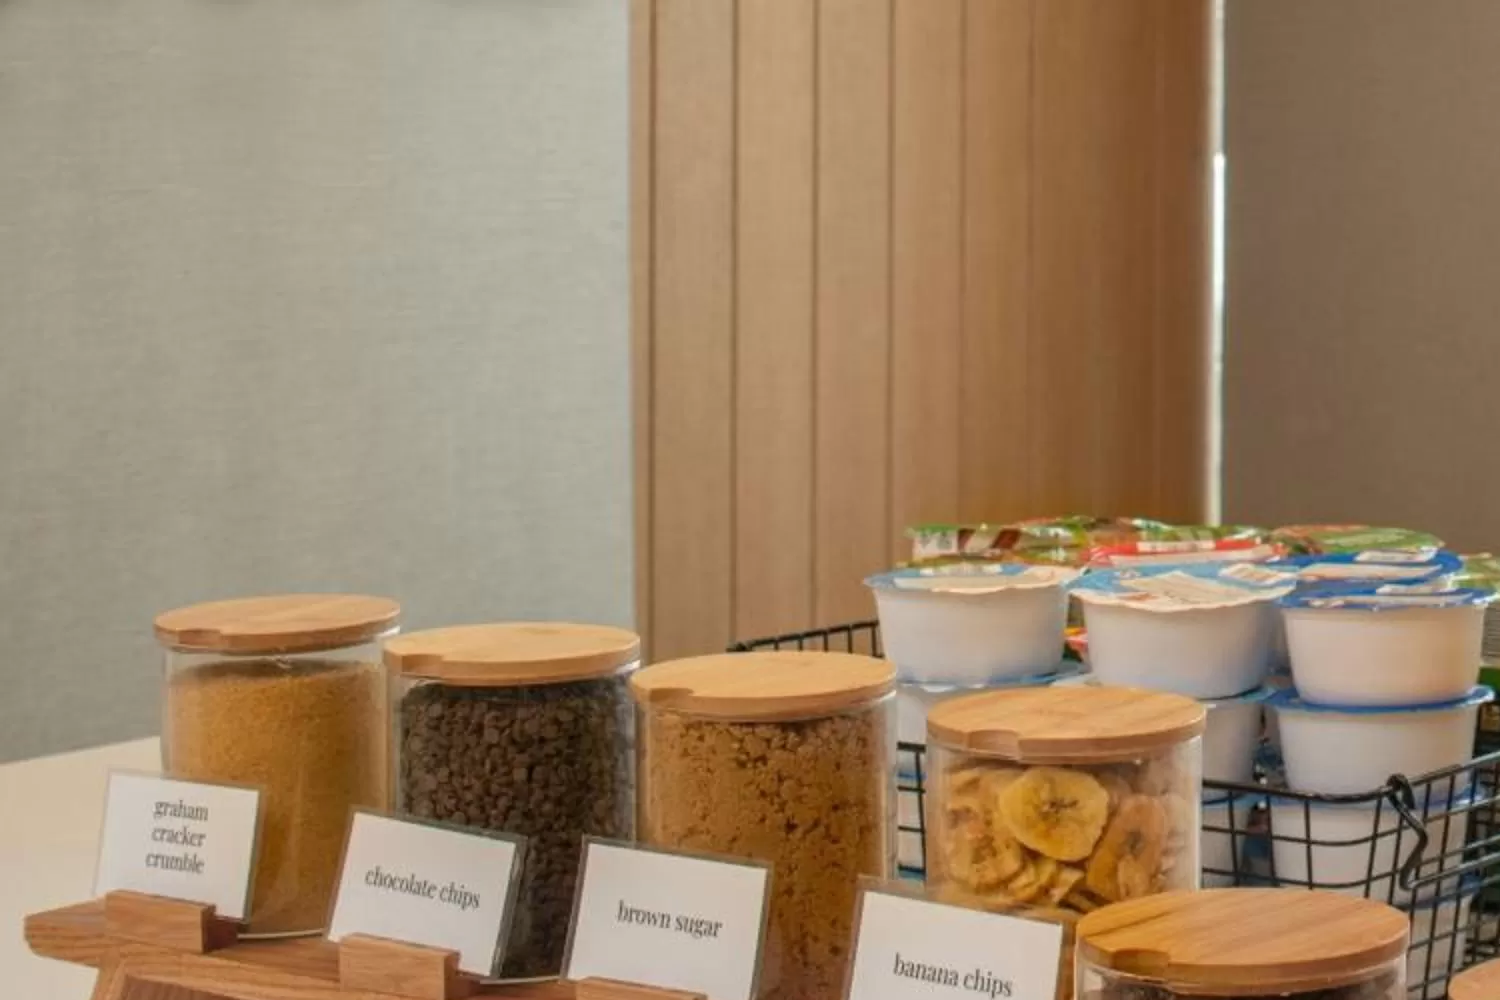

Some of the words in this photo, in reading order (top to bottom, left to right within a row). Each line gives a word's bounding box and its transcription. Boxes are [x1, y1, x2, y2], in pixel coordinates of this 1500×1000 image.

[153, 799, 209, 821] graham
[151, 826, 207, 847] cracker
[145, 852, 205, 875] crumble
[364, 865, 438, 900] chocolate
[439, 881, 480, 911] chips
[617, 899, 672, 929] brown
[674, 914, 724, 940] sugar
[893, 952, 959, 987] banana
[963, 968, 1013, 1000] chips
